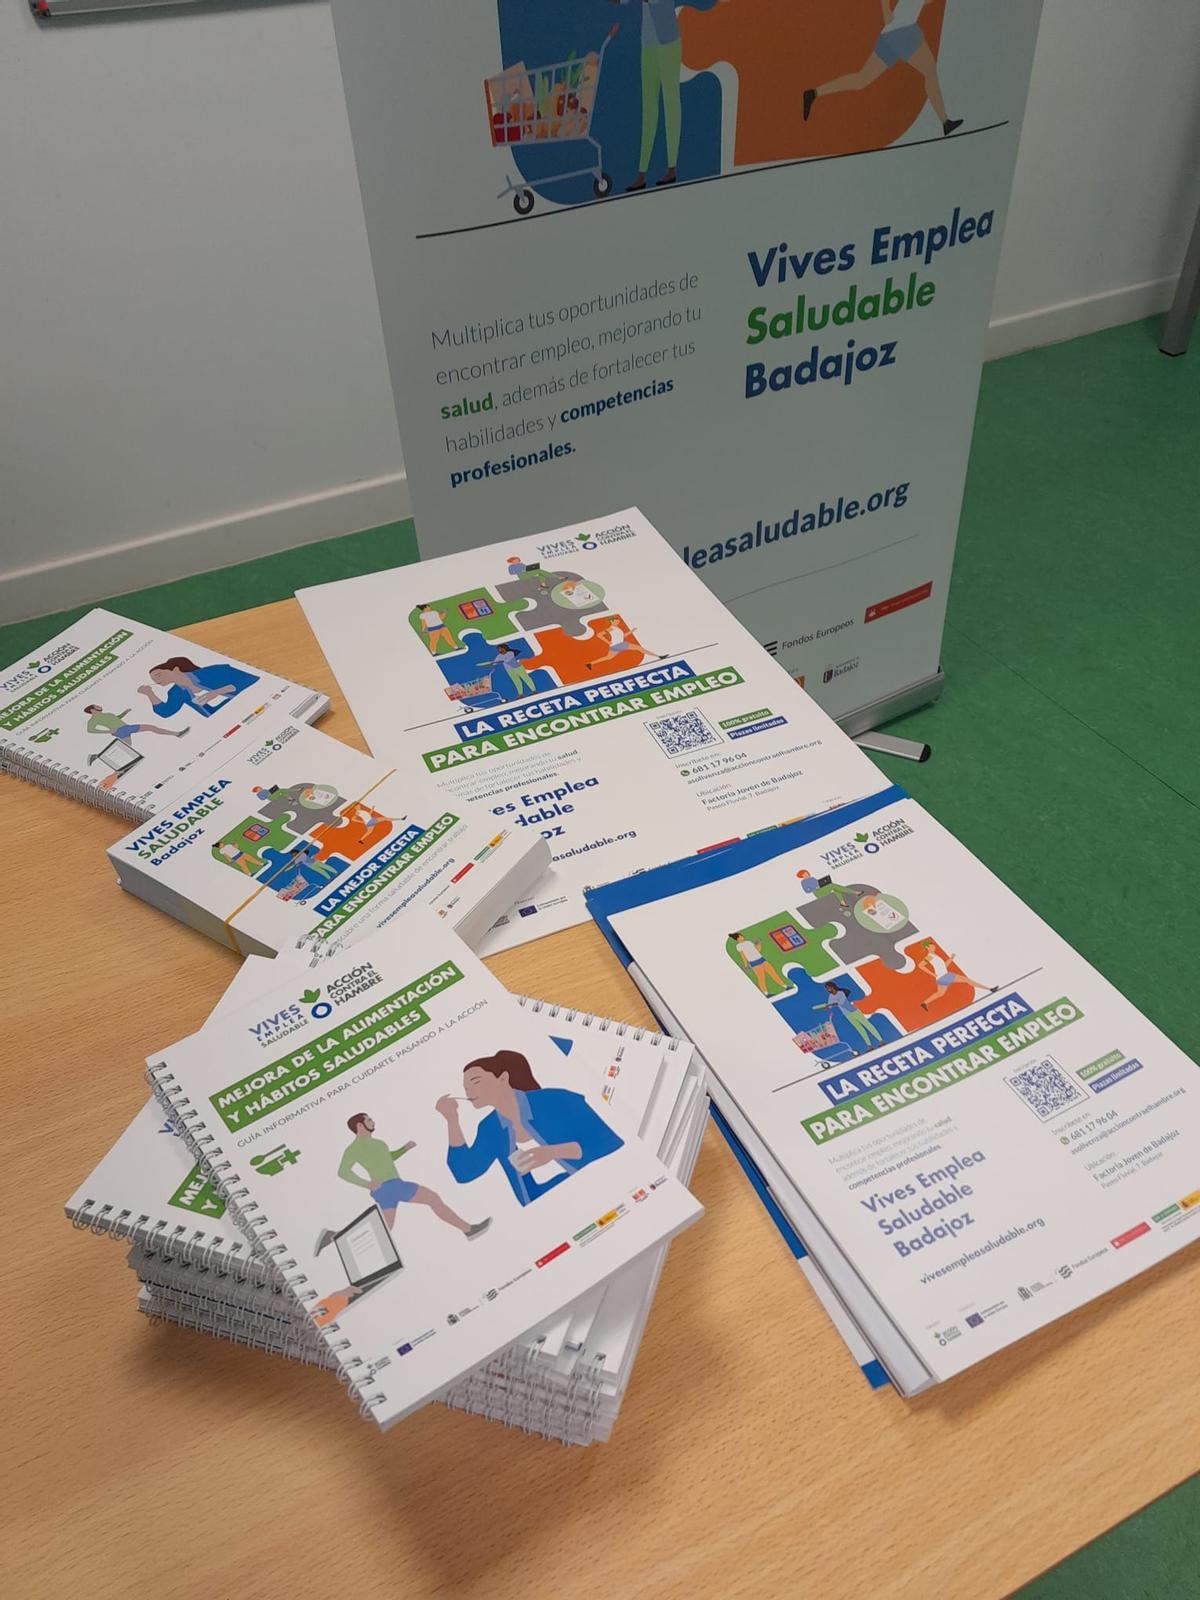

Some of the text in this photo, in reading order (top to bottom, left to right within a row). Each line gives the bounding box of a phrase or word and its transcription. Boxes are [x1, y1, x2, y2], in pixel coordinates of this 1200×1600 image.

[747, 207, 995, 288] Vives Emplea
[431, 272, 699, 350] Multiplica tus oportunidades de
[746, 272, 936, 345] Saludable
[436, 306, 701, 385] encontrar empleo, mejorando tu
[745, 339, 898, 399] Badajoz
[440, 341, 696, 420] salud, además de fortalecer tus
[445, 377, 674, 453] habilidades y competencias
[450, 441, 576, 488] profesionales.
[782, 618, 855, 650] Fondos Europeos
[34, 686, 49, 697] DE
[48, 677, 63, 688] LA
[62, 630, 128, 679] ALIMENTACIÓN
[57, 655, 113, 693] SALUDABLES
[430, 671, 739, 769] PARA ENCONTRAR EMPLEO
[461, 664, 690, 738] LA RECETA PERFECTA
[711, 759, 721, 769] 17
[722, 756, 735, 766] 96
[736, 751, 748, 761] 04
[729, 727, 752, 739] Plazas
[521, 776, 600, 807] Emplea
[761, 778, 771, 787] de
[126, 820, 173, 852] VIVES
[172, 779, 232, 820] EMPLEA
[138, 797, 224, 860] SALUDABLE
[872, 817, 905, 837] ACCIÓN
[880, 828, 915, 847] HAMBRE
[150, 827, 205, 867] Badajoz
[320, 897, 341, 912] LA
[339, 862, 381, 898] MEJOR
[377, 830, 420, 863] RECETA
[342, 852, 414, 914] ENCONTRAR
[410, 816, 453, 853] EMPLEO
[819, 842, 856, 861] VIVES
[377, 857, 455, 928] vivesempleasaludable.org
[326, 961, 373, 994] ACCIÓN
[329, 969, 379, 999] CONTRA EL
[334, 975, 384, 1006] HAMBRE
[217, 966, 457, 1109] MEJORA DE LA ALIMENTACIÓN
[248, 1003, 301, 1036] VIVES
[256, 1013, 305, 1042] EMPLEA
[260, 1018, 310, 1049] SALUDABLE
[227, 1010, 422, 1124] Y HÁBITOS SALUDABLES
[236, 998, 489, 1149] GUÍA INFORMATIVA PARA CUIDARTE PASANDO A LA ACCIÓN
[808, 1002, 1077, 1142] PARA ENCONTRAR EMPLEO
[826, 1000, 1028, 1101] LA RECETA PERFECTA
[1070, 1110, 1119, 1141] 681 17 96 04
[201, 1198, 218, 1210] Y
[848, 1165, 898, 1191] competencias
[860, 1184, 917, 1213] Vives
[915, 1149, 986, 1189] Emplea
[878, 1183, 974, 1236] Saludable
[893, 1210, 975, 1258] Badajoz
[920, 1217, 1046, 1285] vivesempleasaludable.org
